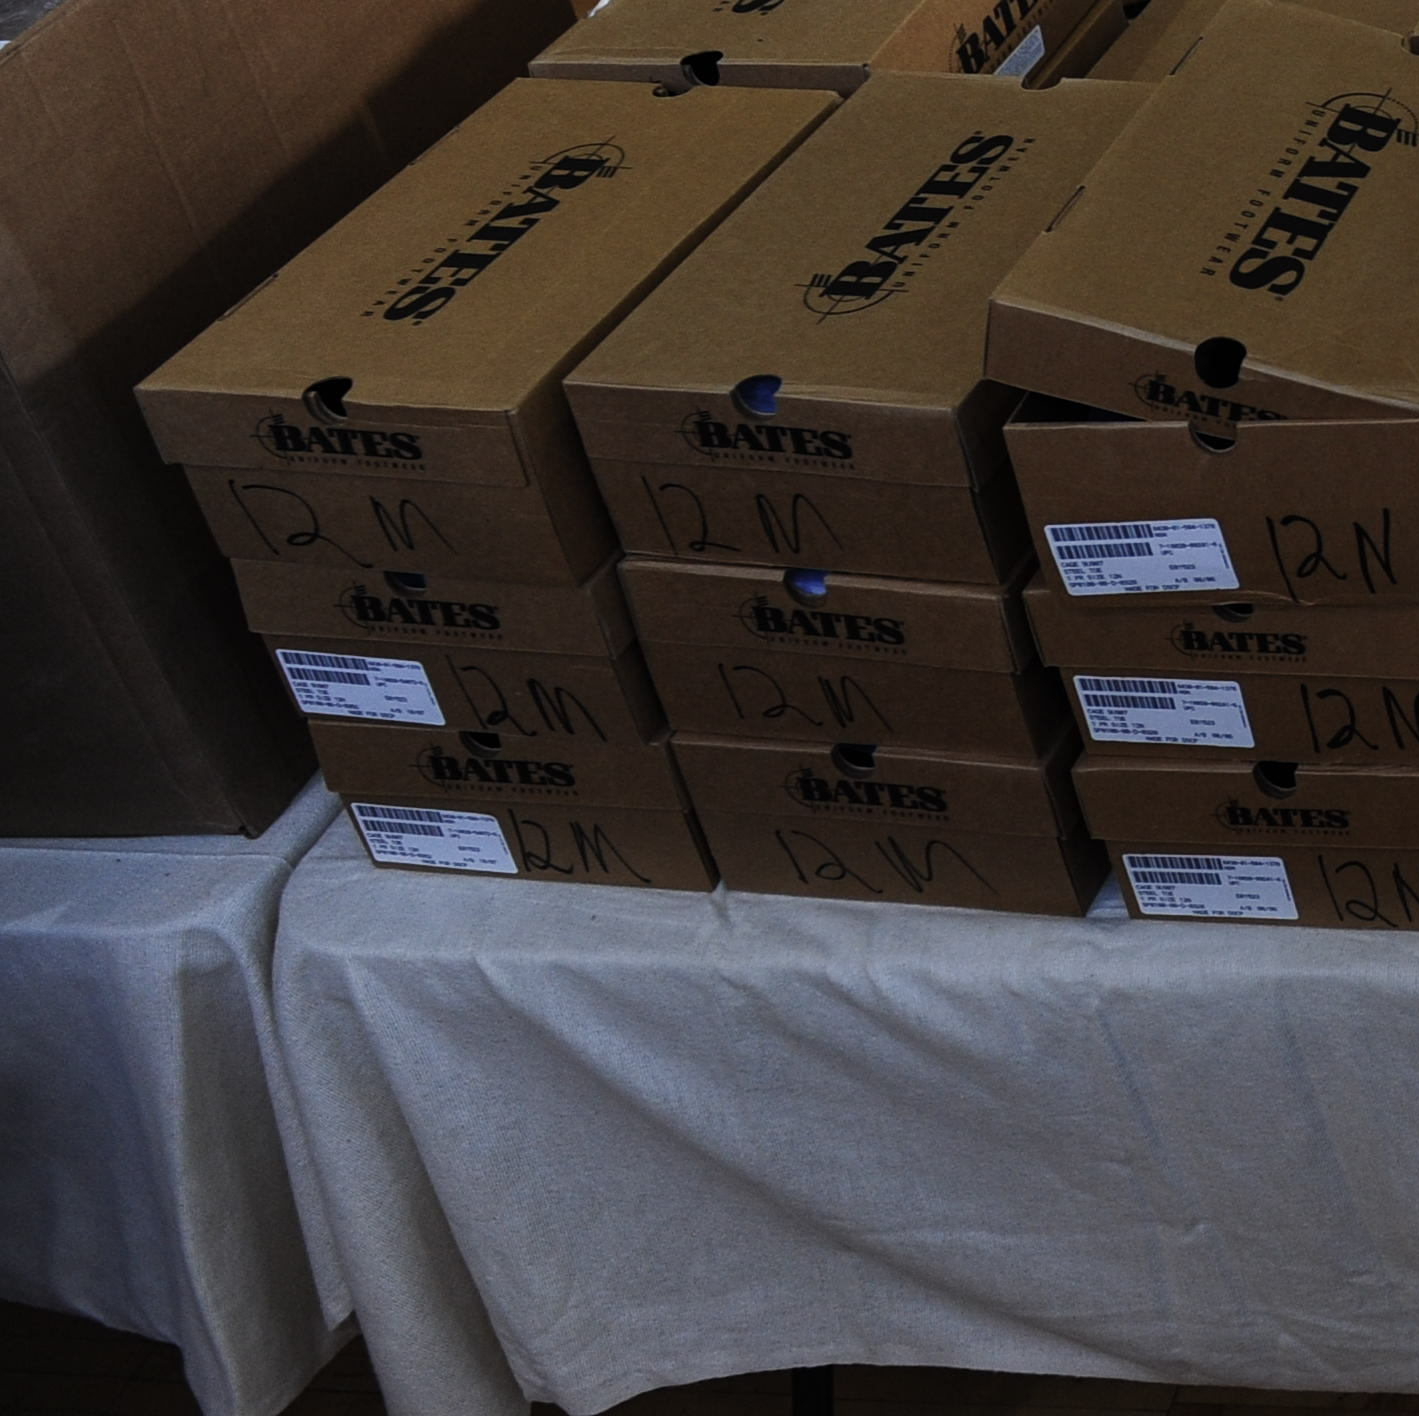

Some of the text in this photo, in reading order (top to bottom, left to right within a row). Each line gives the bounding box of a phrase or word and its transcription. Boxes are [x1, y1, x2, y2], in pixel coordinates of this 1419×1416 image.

[1199, 108, 1326, 278] UNIFORM FOOTWEAR
[1229, 104, 1402, 296] BATES
[819, 135, 1015, 300] BATES
[383, 156, 611, 321] BATES
[269, 424, 424, 460] BATES
[695, 421, 853, 460] BATES
[351, 595, 501, 630] BATES
[752, 606, 906, 645] BATES
[1181, 629, 1307, 655] BATES
[429, 756, 577, 788] BATES
[797, 777, 948, 813] BATES
[1226, 807, 1351, 830] BATES
